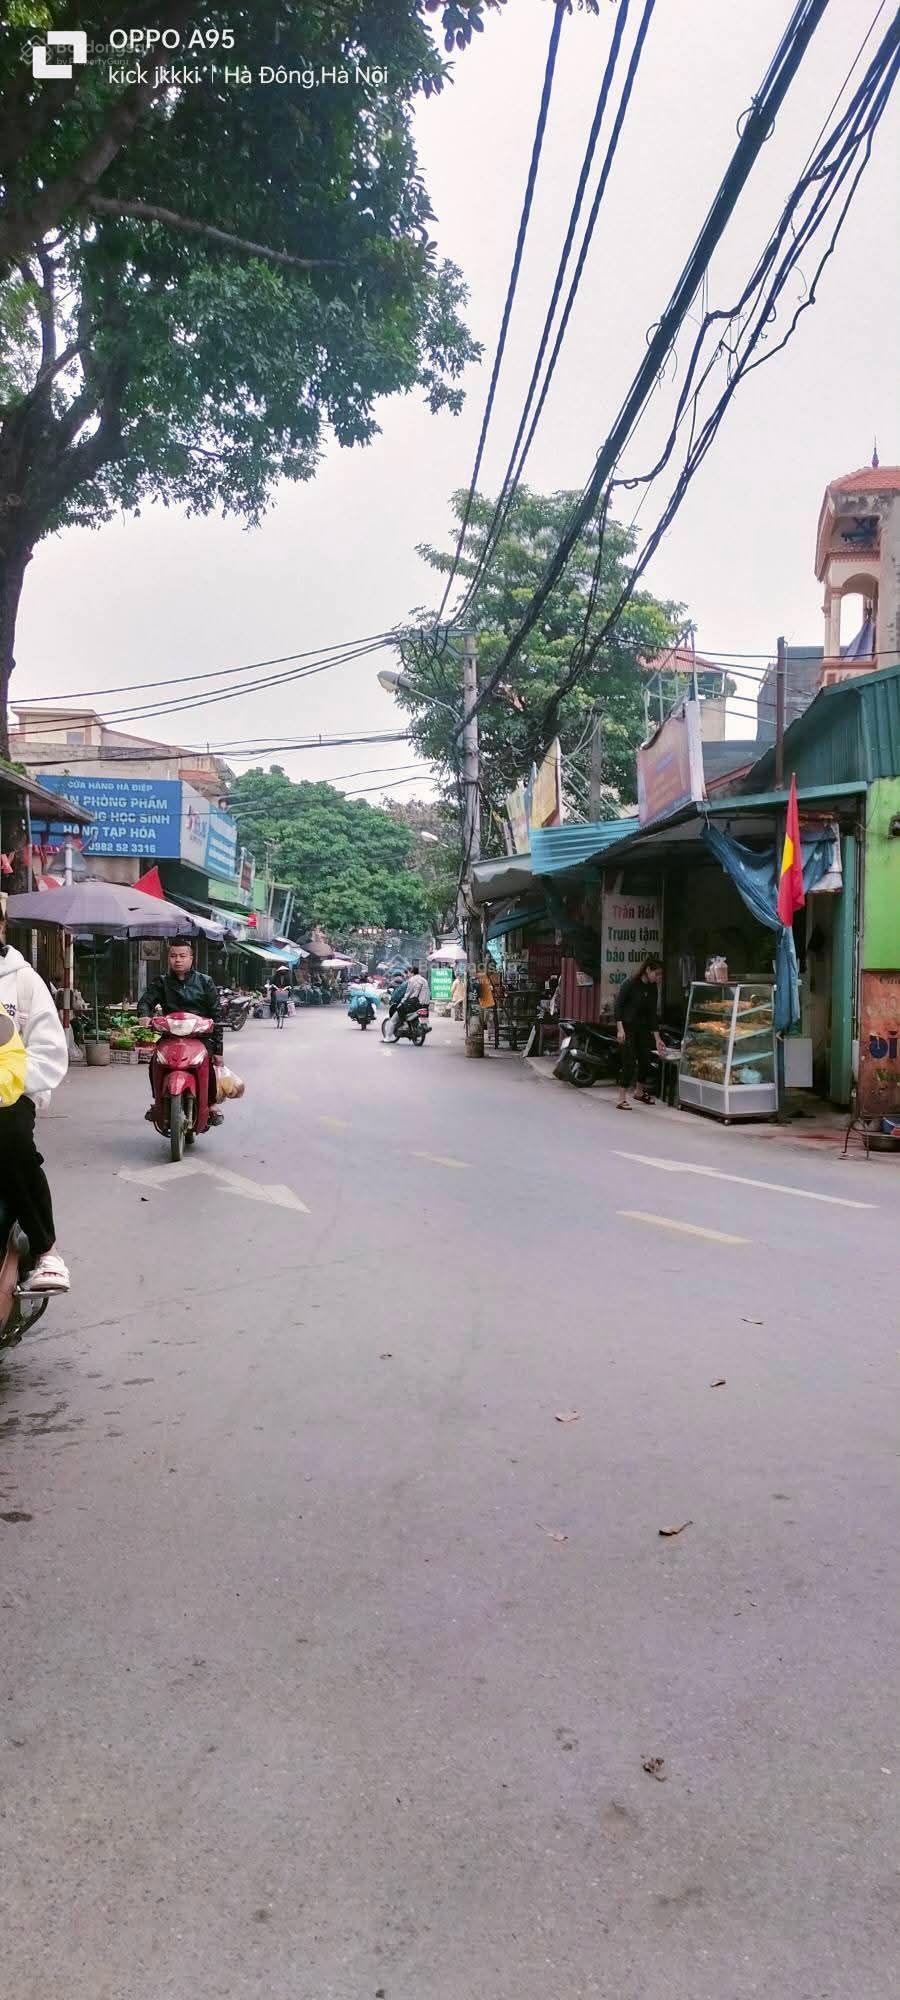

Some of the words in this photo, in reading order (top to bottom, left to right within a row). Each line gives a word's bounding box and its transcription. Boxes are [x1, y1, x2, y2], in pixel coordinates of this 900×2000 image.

[111, 812, 136, 825] HỌC
[140, 815, 170, 825] SINH
[102, 826, 127, 840] TẠP
[116, 843, 129, 853] 52
[608, 927, 636, 942] Trung
